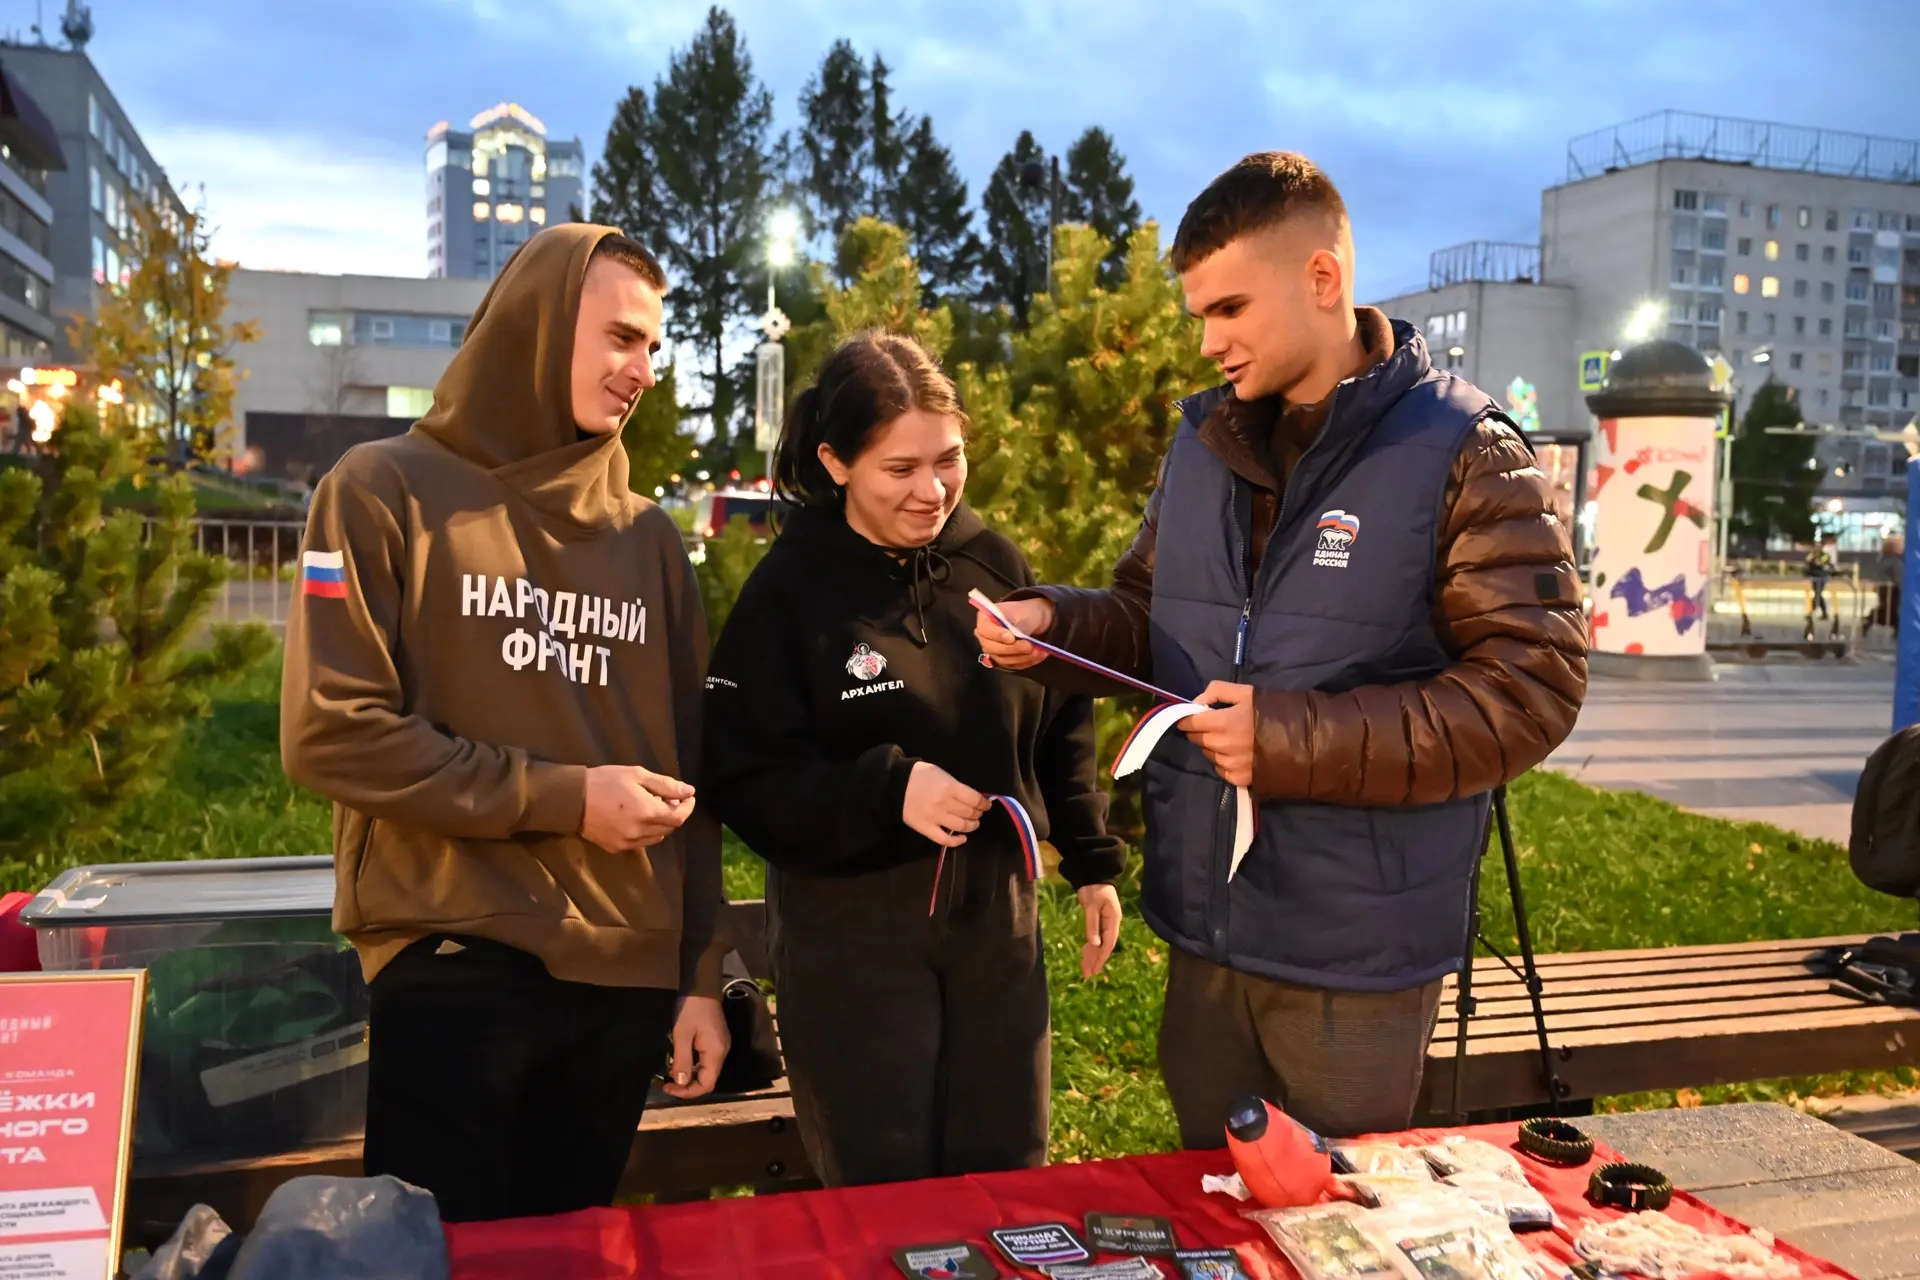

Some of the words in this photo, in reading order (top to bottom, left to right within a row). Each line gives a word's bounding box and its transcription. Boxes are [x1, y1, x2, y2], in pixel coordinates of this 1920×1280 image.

[1314, 550, 1350, 559] ЕДИНАЯ
[1313, 558, 1348, 568] РОССИЯ
[462, 574, 646, 645] НАРОДНЫЙ
[502, 628, 611, 686] ФРОНТ
[841, 679, 905, 701] АРХАНГЕЛ
[5, 1068, 75, 1079] КОМАНДА
